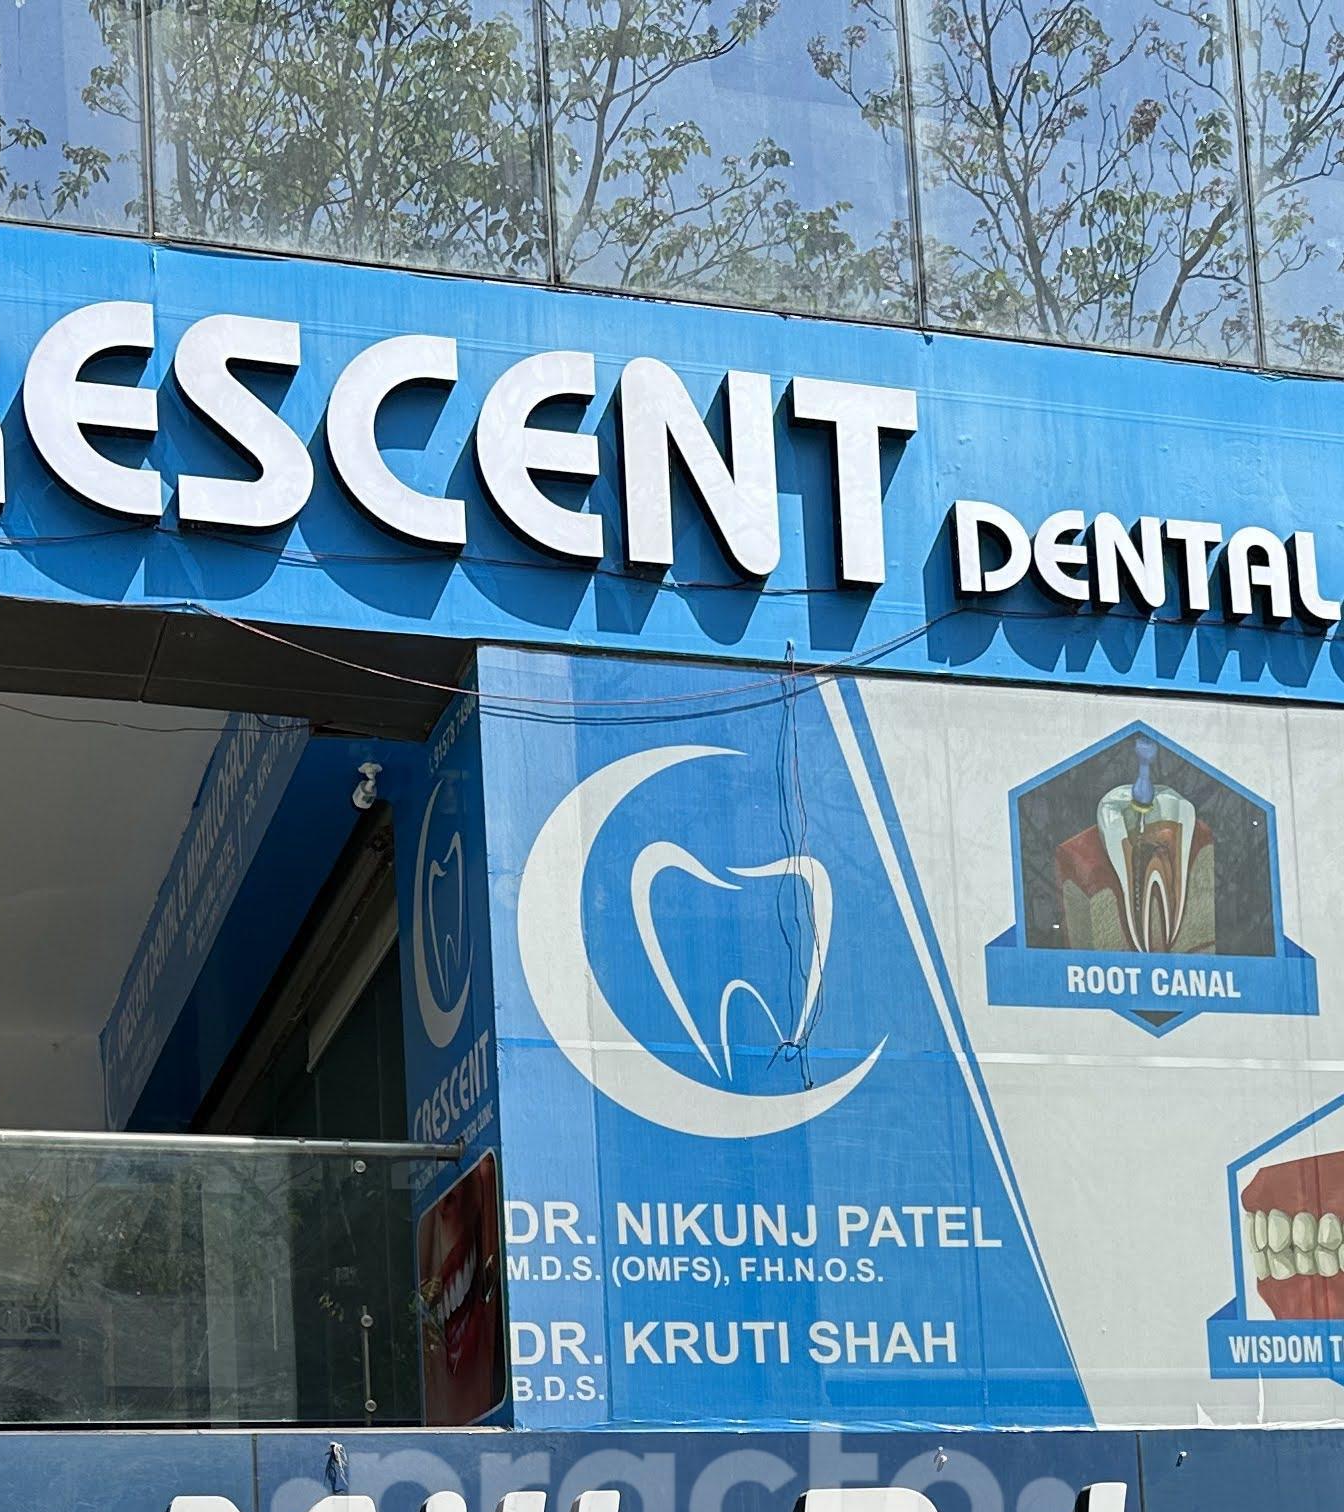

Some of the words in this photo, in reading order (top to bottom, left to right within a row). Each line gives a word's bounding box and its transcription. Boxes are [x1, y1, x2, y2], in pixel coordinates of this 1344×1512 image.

[953, 499, 1342, 623] DENTAL
[1066, 965, 1146, 996] ROOT
[1150, 968, 1242, 998] CANAL
[413, 1029, 490, 1142] CRESCENT
[504, 1200, 596, 1246] DR.
[616, 1202, 817, 1248] NIKUNJ
[838, 1205, 1003, 1249] PATEL
[506, 1256, 601, 1282] M.D.S.
[611, 1256, 730, 1287] (OMFS),
[740, 1257, 883, 1284] F.H.N.O.S.
[510, 1321, 604, 1366] DR.
[624, 1321, 790, 1365] KRUTI
[808, 1320, 956, 1364] SHAH
[1228, 1334, 1324, 1365] WISDOM
[513, 1376, 606, 1402] B.D.S.
